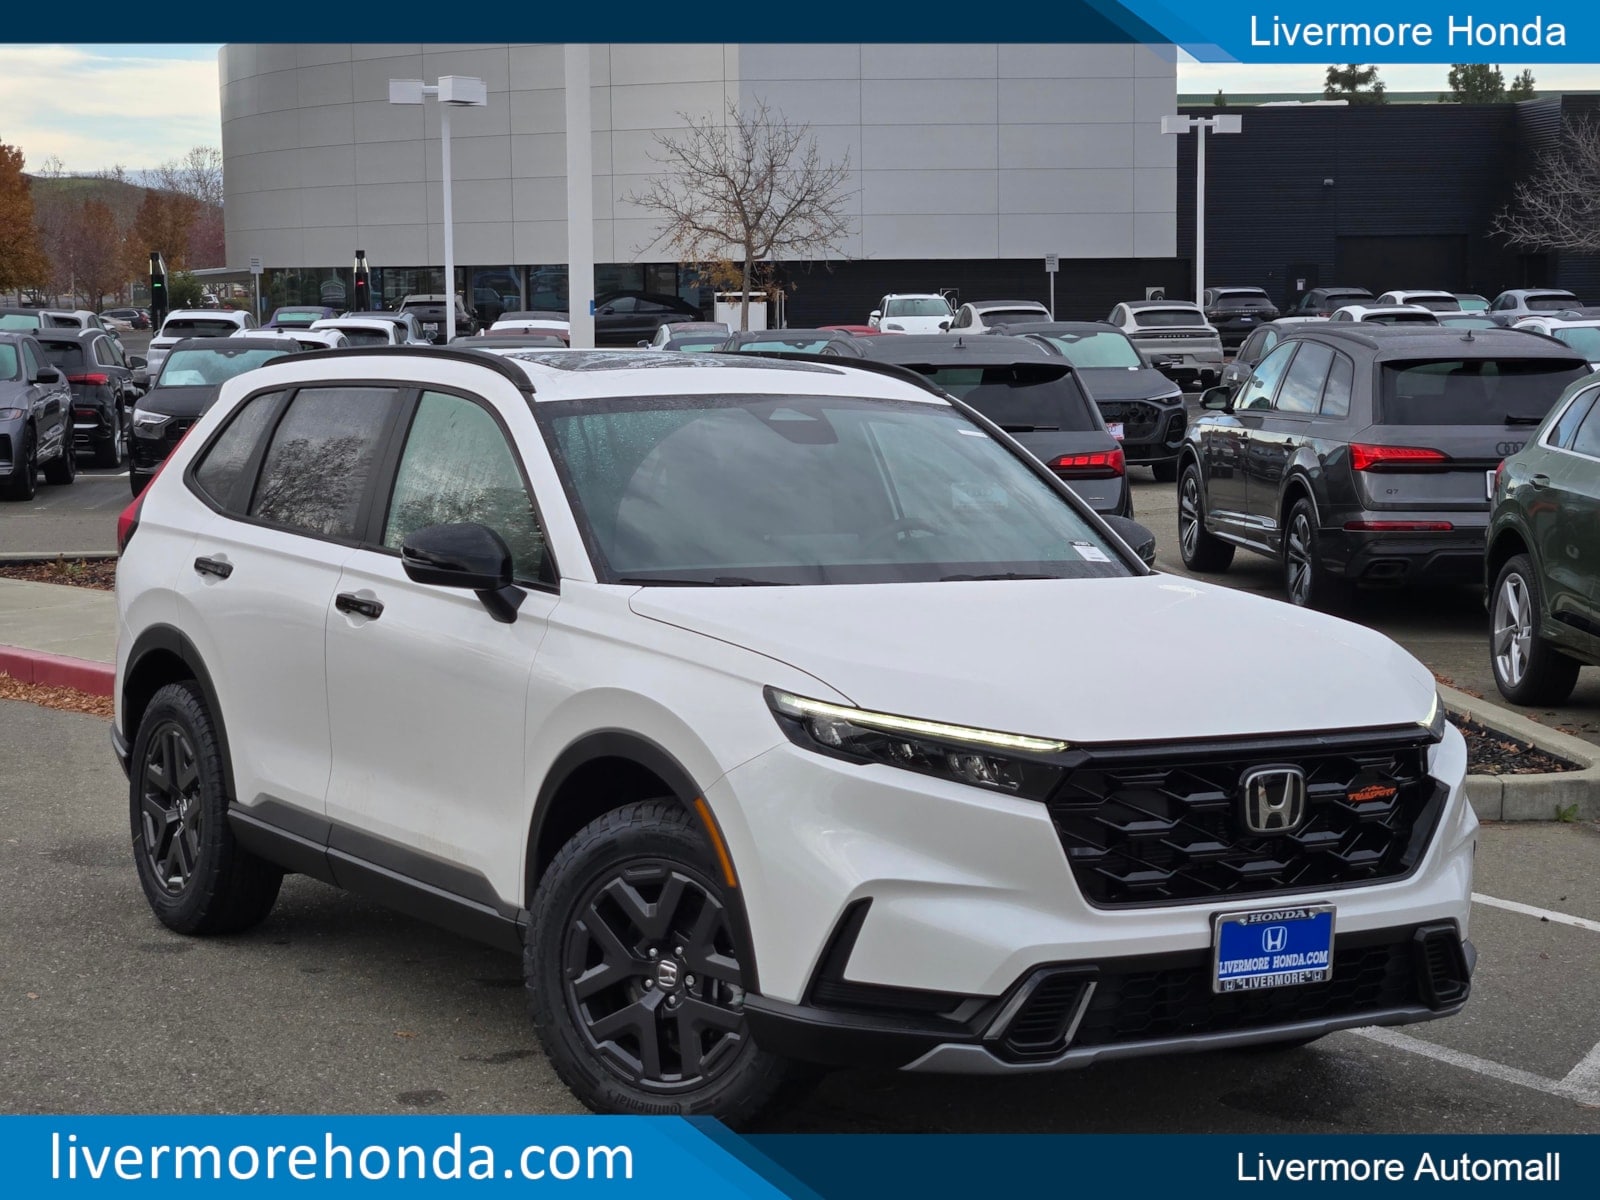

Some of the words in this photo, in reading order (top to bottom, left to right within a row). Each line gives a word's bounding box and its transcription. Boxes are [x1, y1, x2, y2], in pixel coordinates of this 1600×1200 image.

[1248, 909, 1307, 923] HONDA
[1218, 956, 1270, 974] LIVERMORE
[1272, 950, 1329, 969] HONDA.COM
[1242, 971, 1306, 989] LIVERMORE
